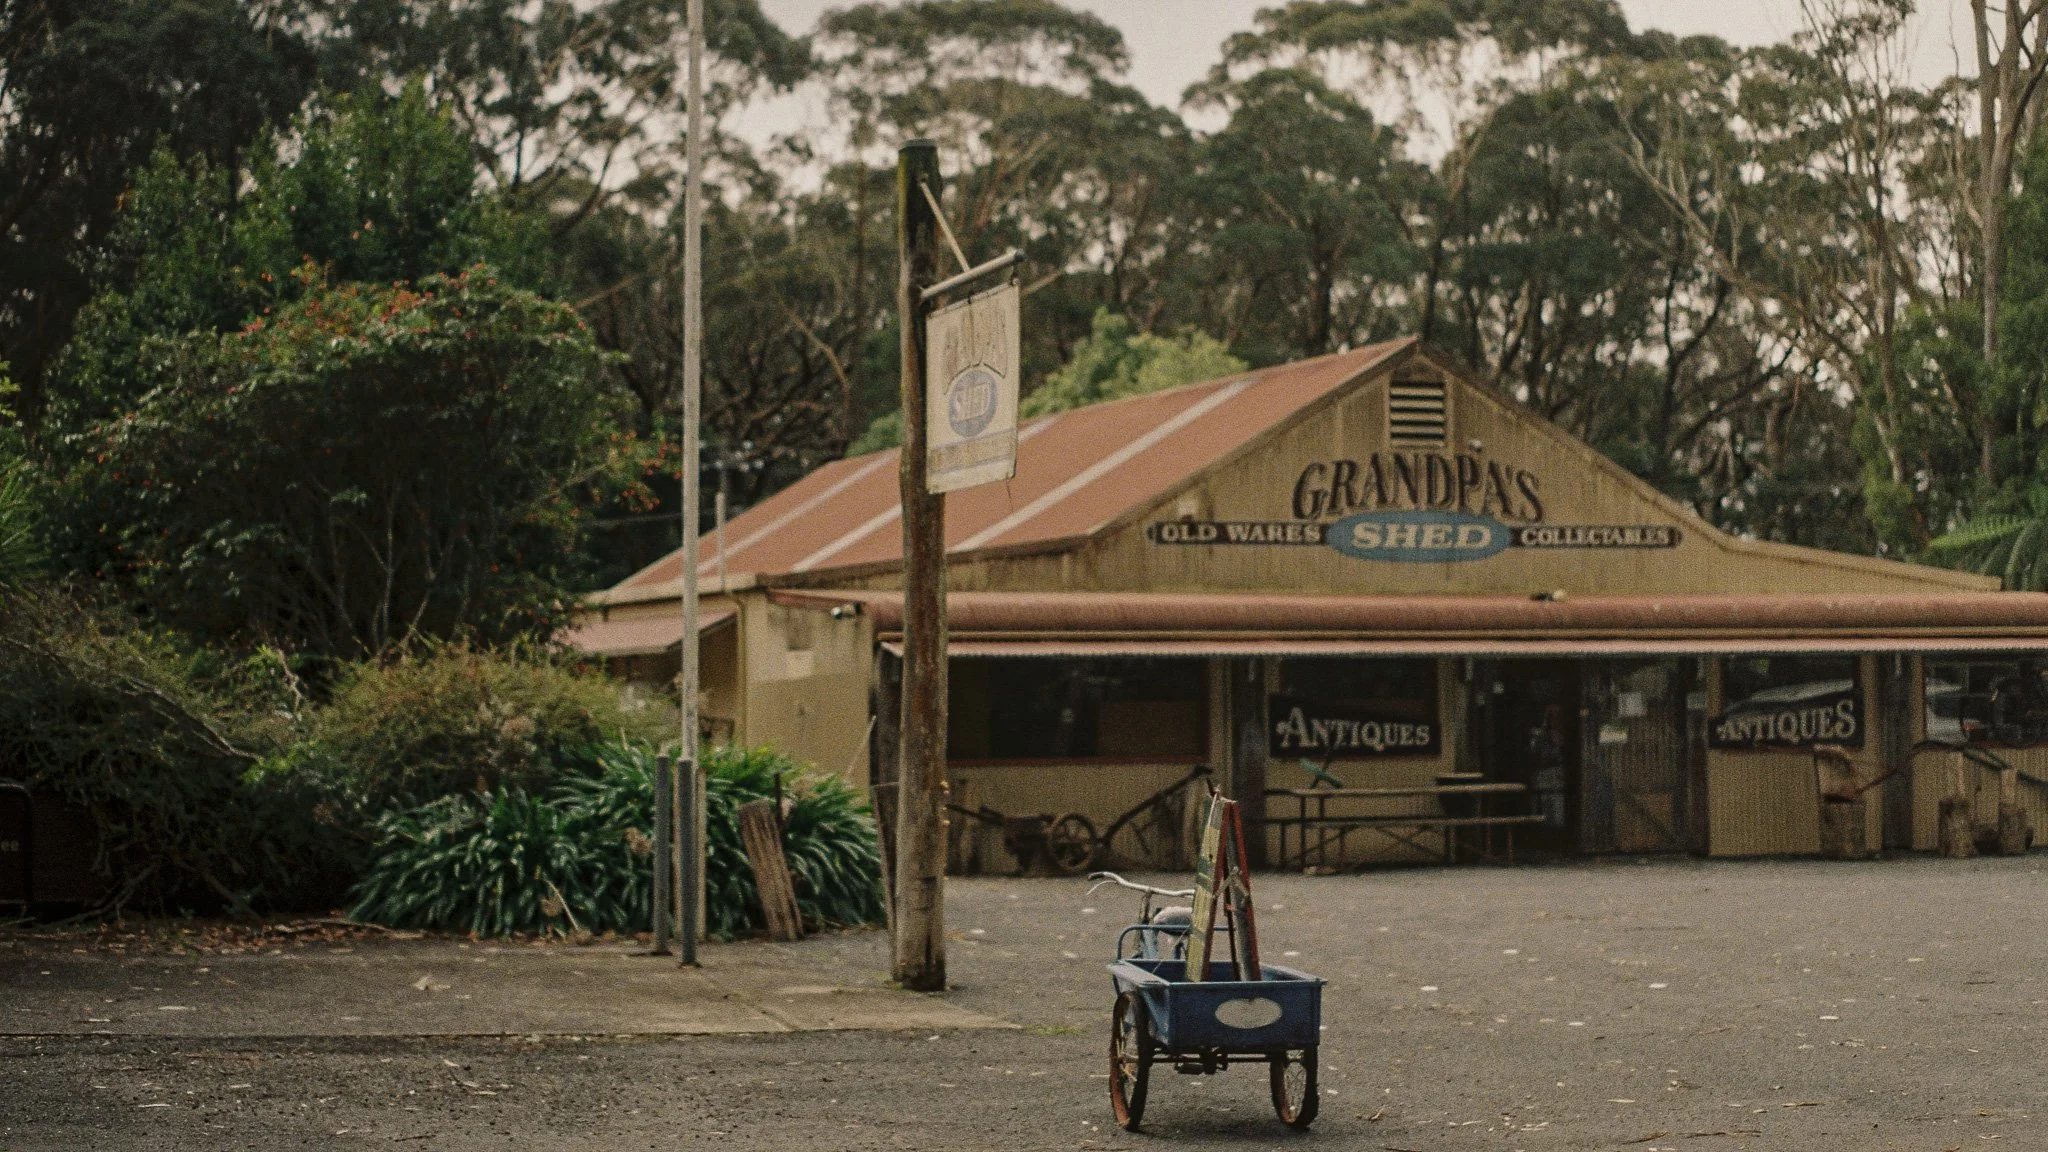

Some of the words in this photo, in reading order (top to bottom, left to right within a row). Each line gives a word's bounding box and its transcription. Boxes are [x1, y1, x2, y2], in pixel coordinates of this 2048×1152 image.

[1292, 452, 1543, 523] GRANDPA'S
[1161, 523, 1218, 543] OLD
[1227, 523, 1322, 543] WARES
[1352, 522, 1492, 549] SHED
[1521, 528, 1669, 545] COLLECTABLES
[1276, 707, 1430, 751] ANTIQUES
[1716, 700, 1856, 745] ANTIQUES
